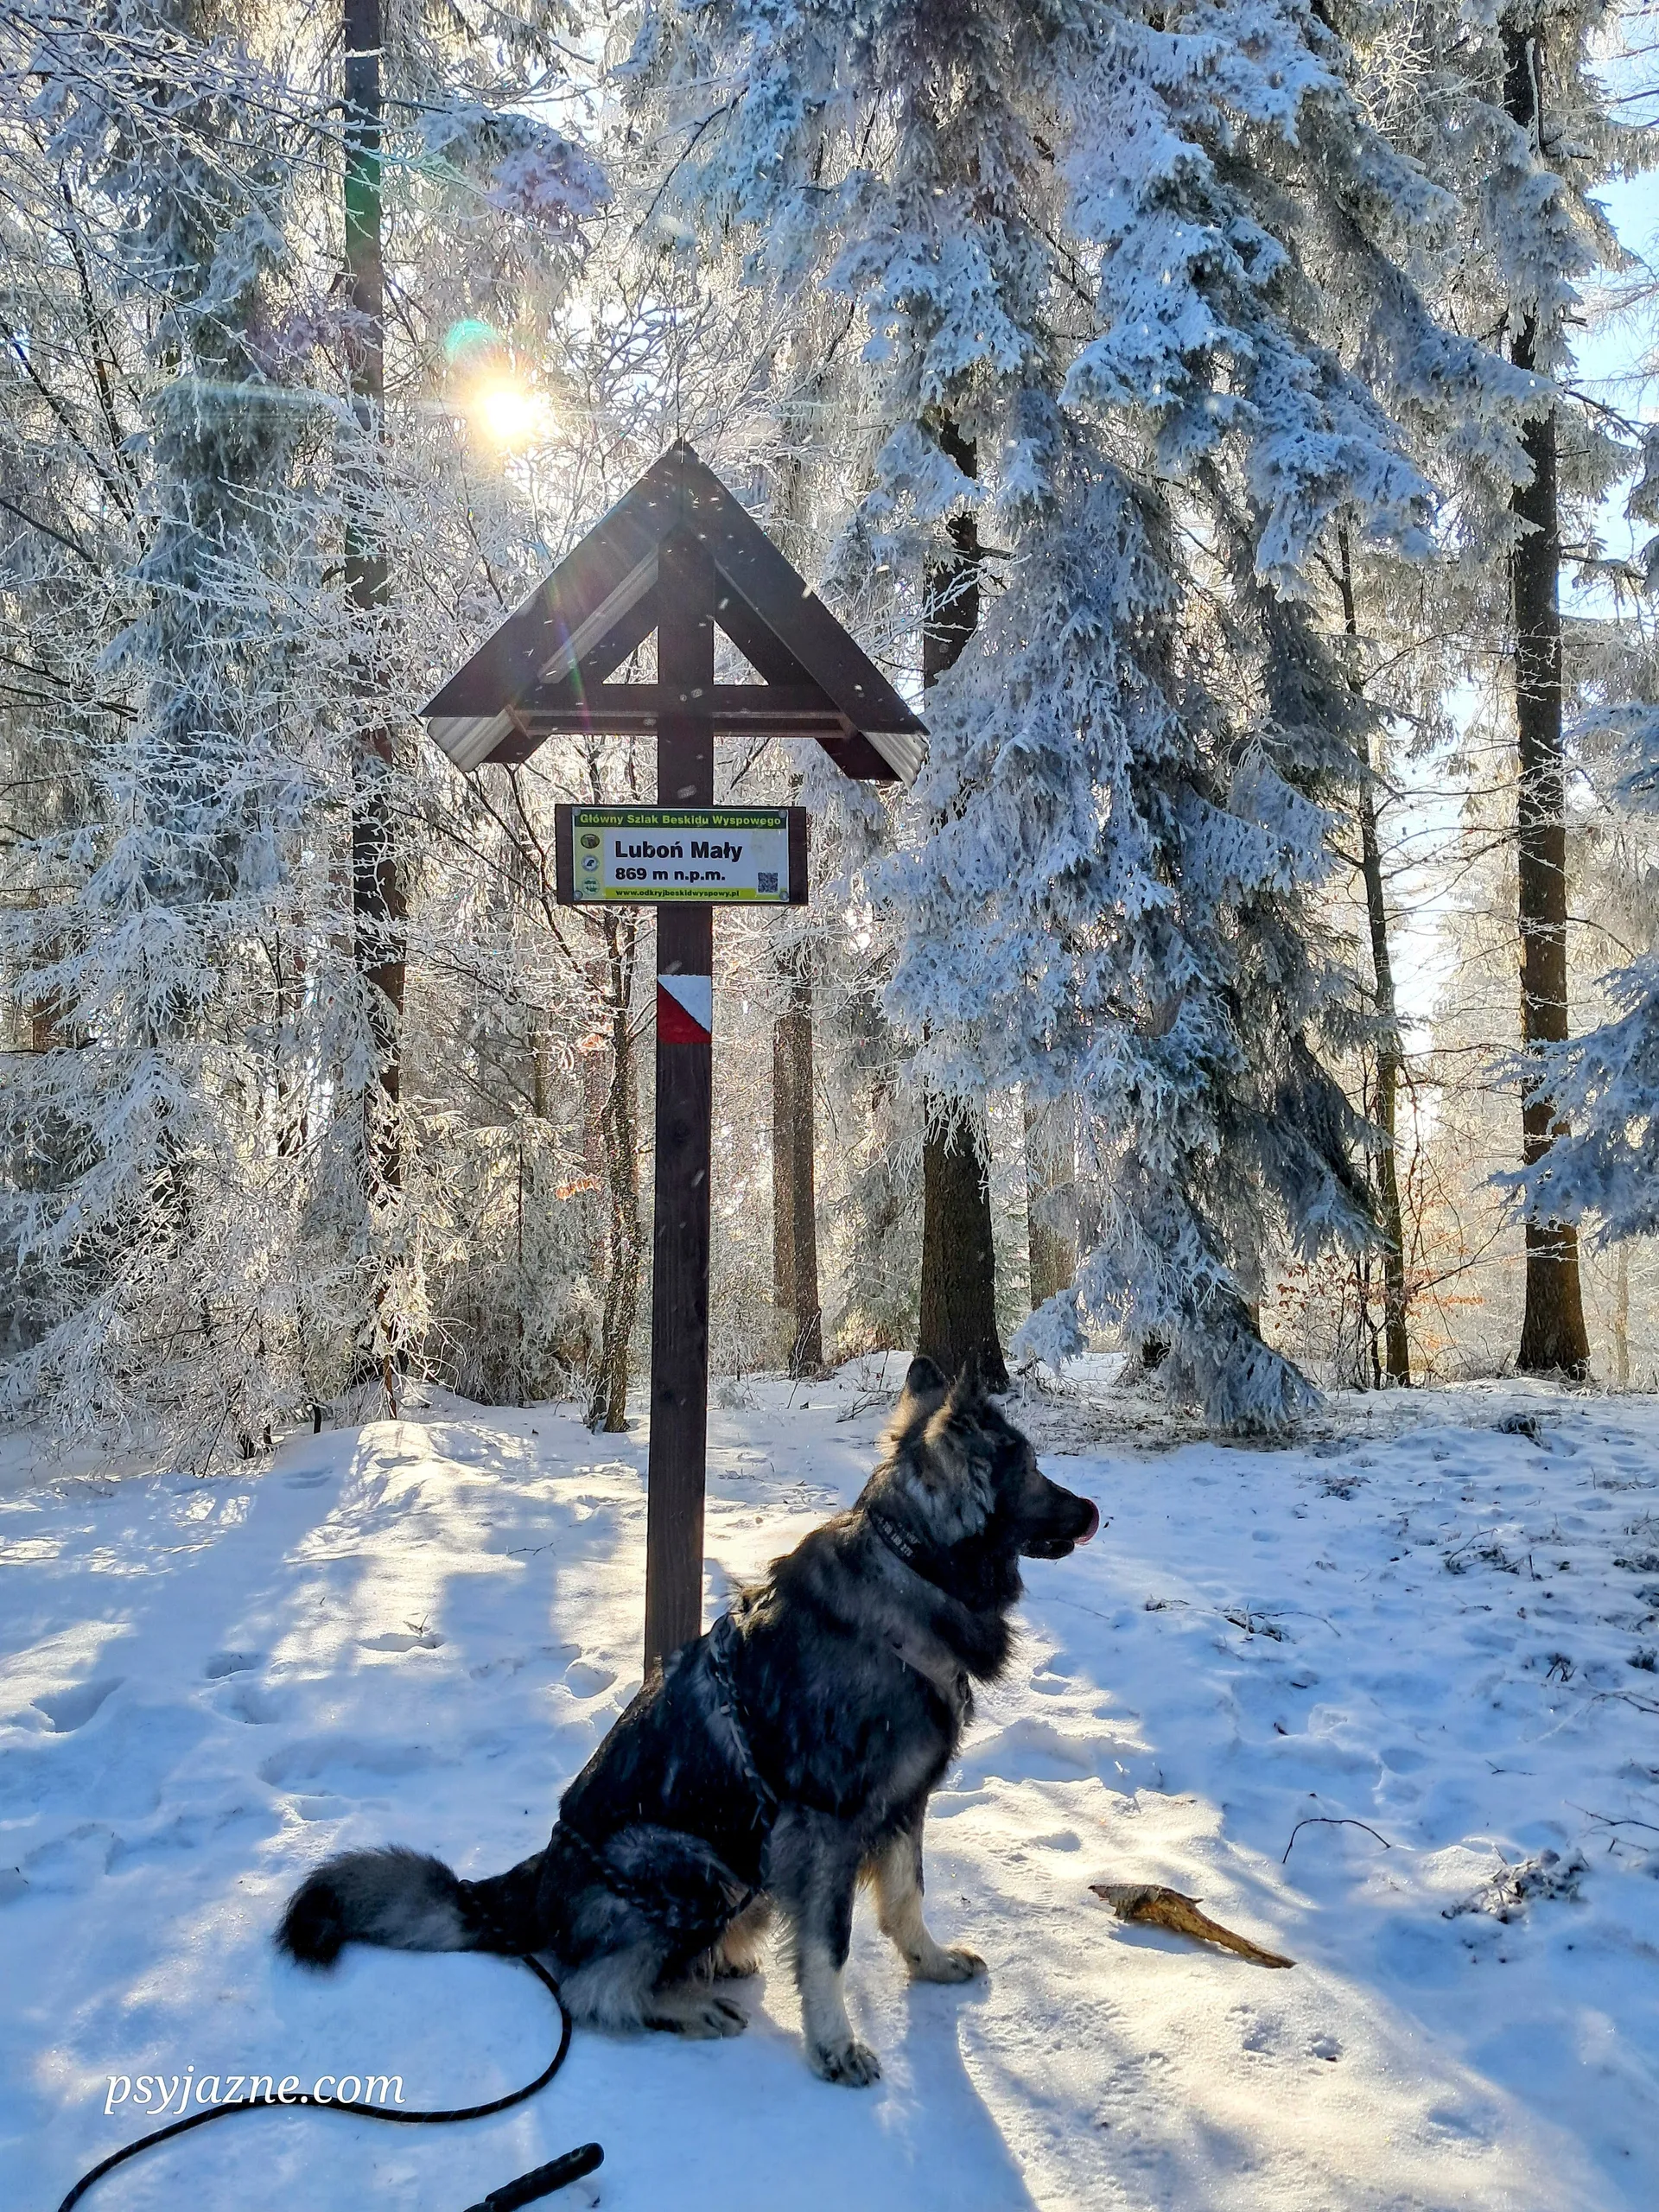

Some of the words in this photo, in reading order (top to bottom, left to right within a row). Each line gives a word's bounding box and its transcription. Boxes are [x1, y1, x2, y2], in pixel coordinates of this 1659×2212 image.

[580, 814, 624, 825] Główny
[626, 814, 658, 824] Szlak
[662, 815, 709, 825] Beskidu
[712, 815, 781, 827] Wyspowego
[615, 840, 683, 859] Luboń
[691, 841, 743, 862] Mały
[615, 868, 647, 880] 869
[652, 872, 669, 880] m
[674, 872, 726, 883] n.p.m.
[615, 889, 740, 898] www.odkryjbeskidwyspowy.pl
